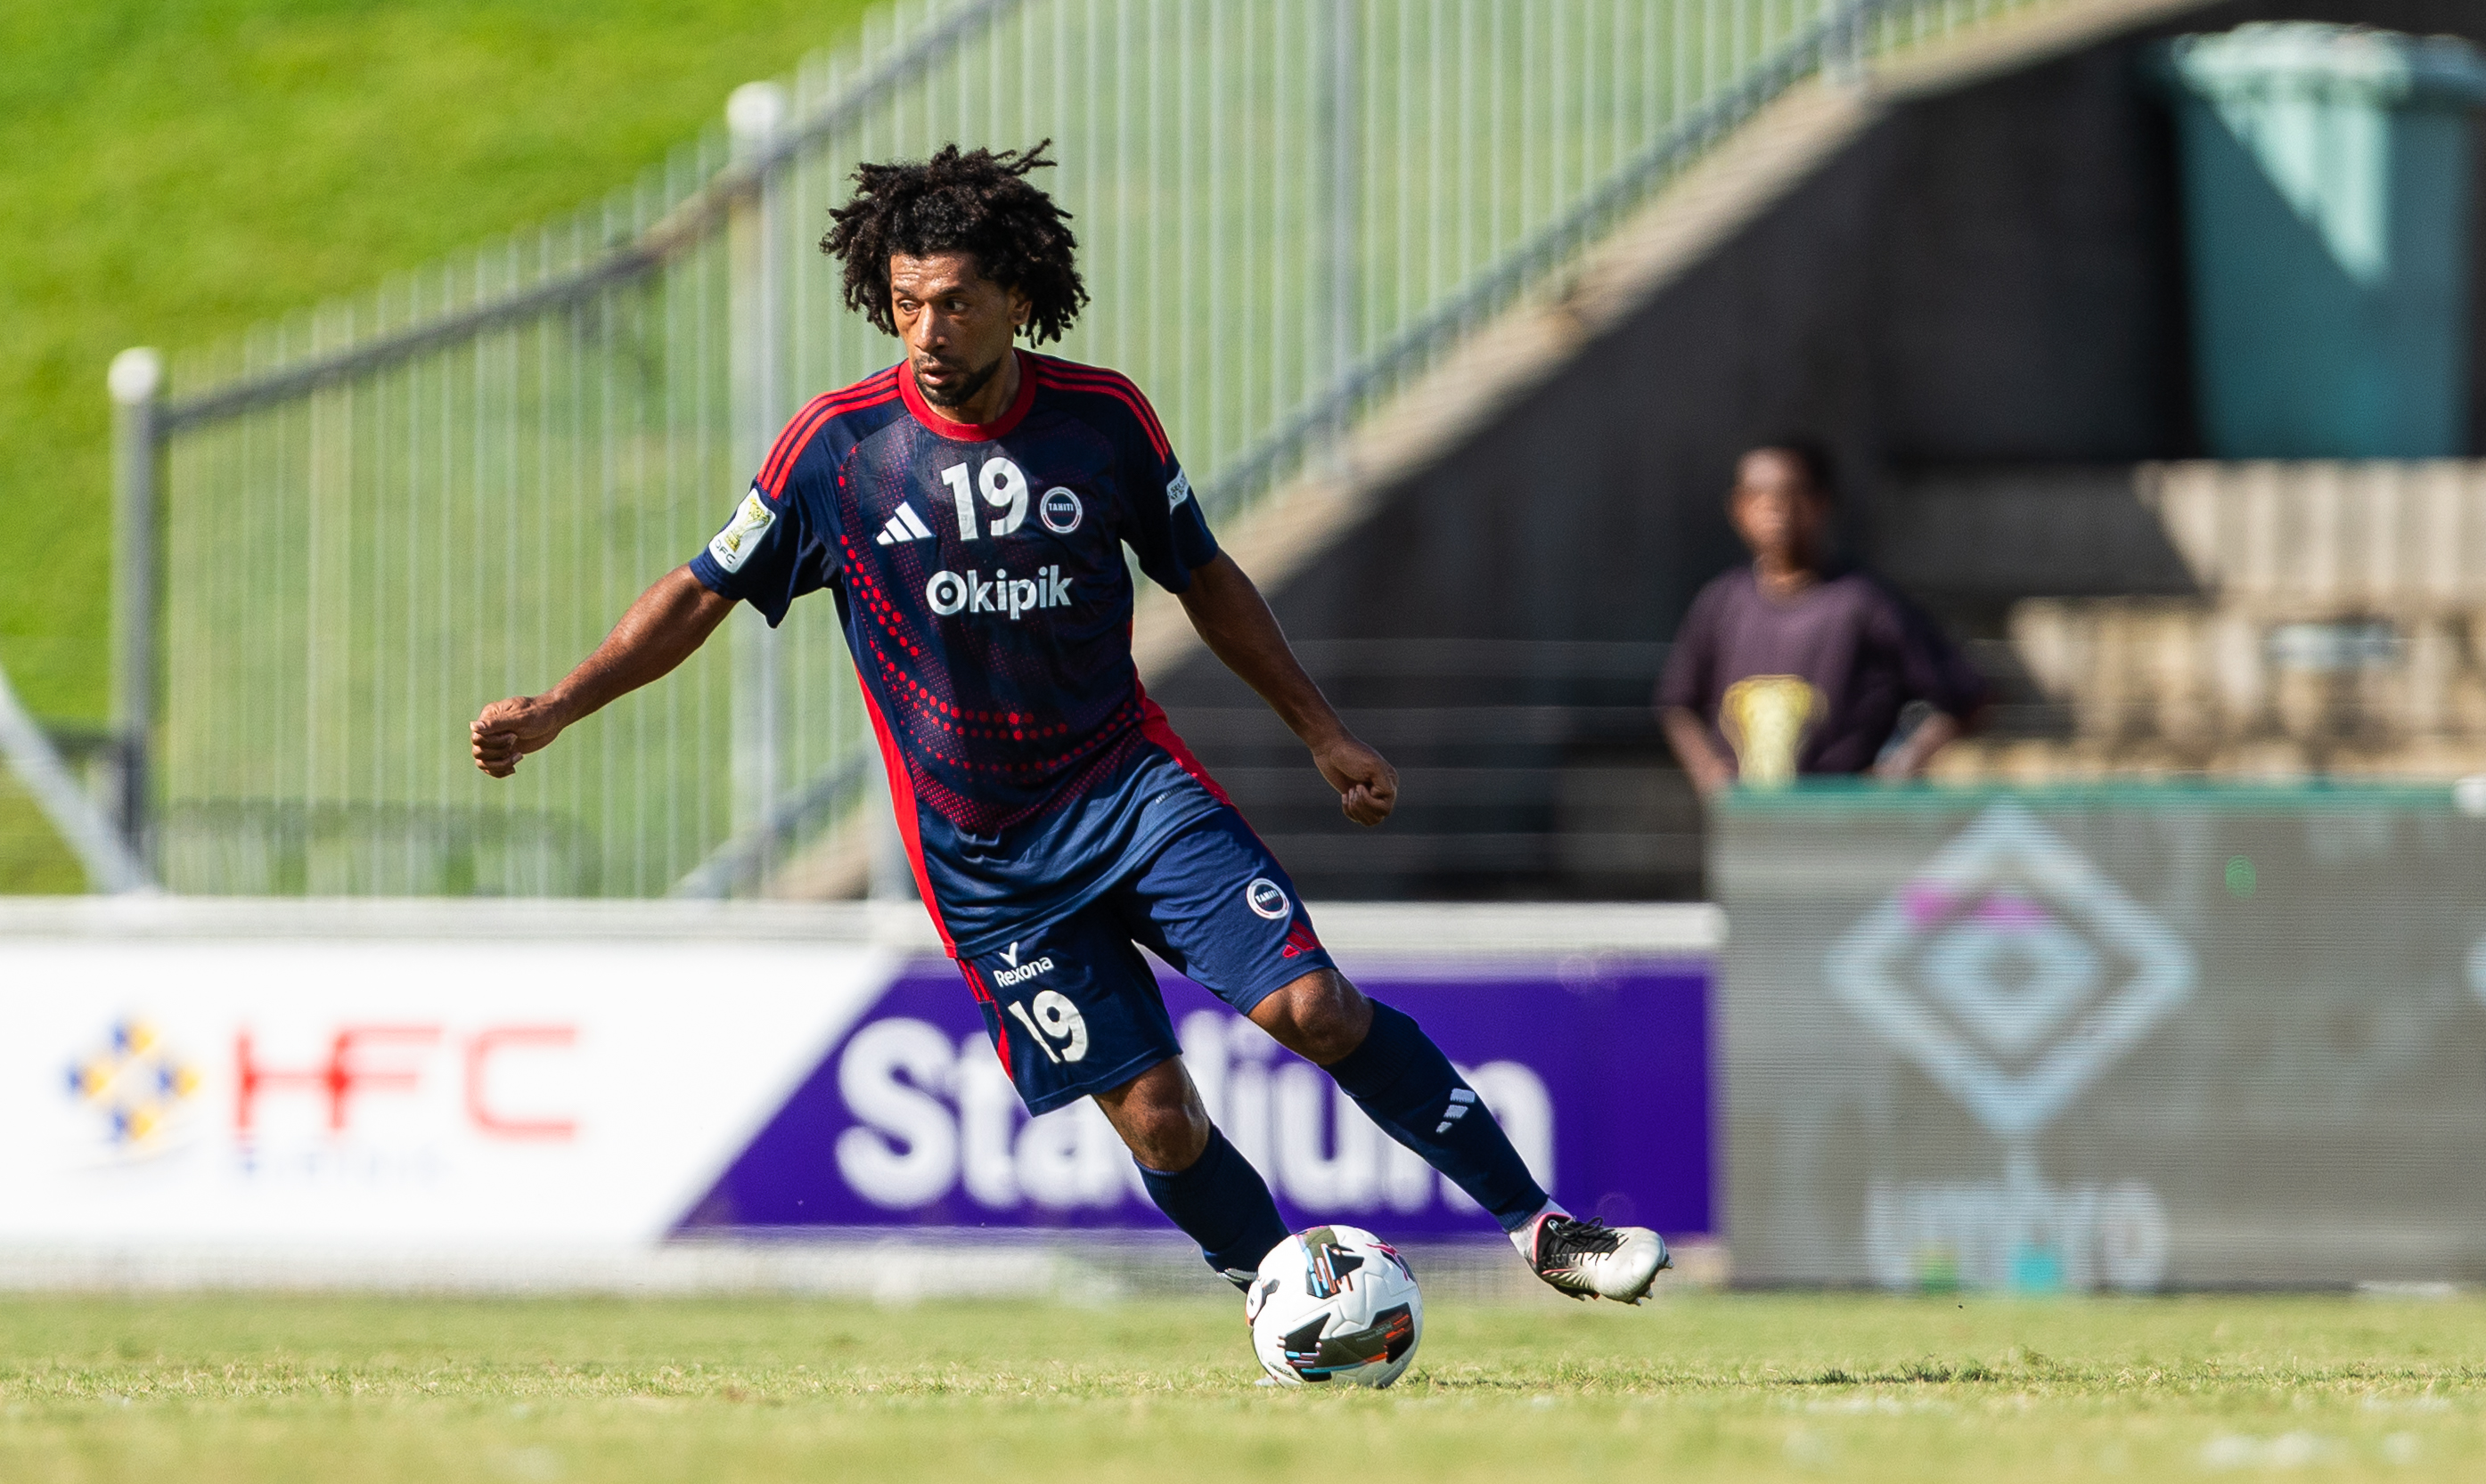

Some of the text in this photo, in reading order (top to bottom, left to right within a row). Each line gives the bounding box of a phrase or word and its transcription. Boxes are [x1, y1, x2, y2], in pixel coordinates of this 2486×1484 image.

[941, 457, 1028, 541] 19
[1048, 503, 1075, 511] TAHITI
[716, 539, 736, 564] OFC
[926, 565, 1074, 620] Okipik
[994, 957, 1055, 988] Rexona
[1008, 990, 1089, 1064] 19
[233, 1022, 582, 1141] HFC
